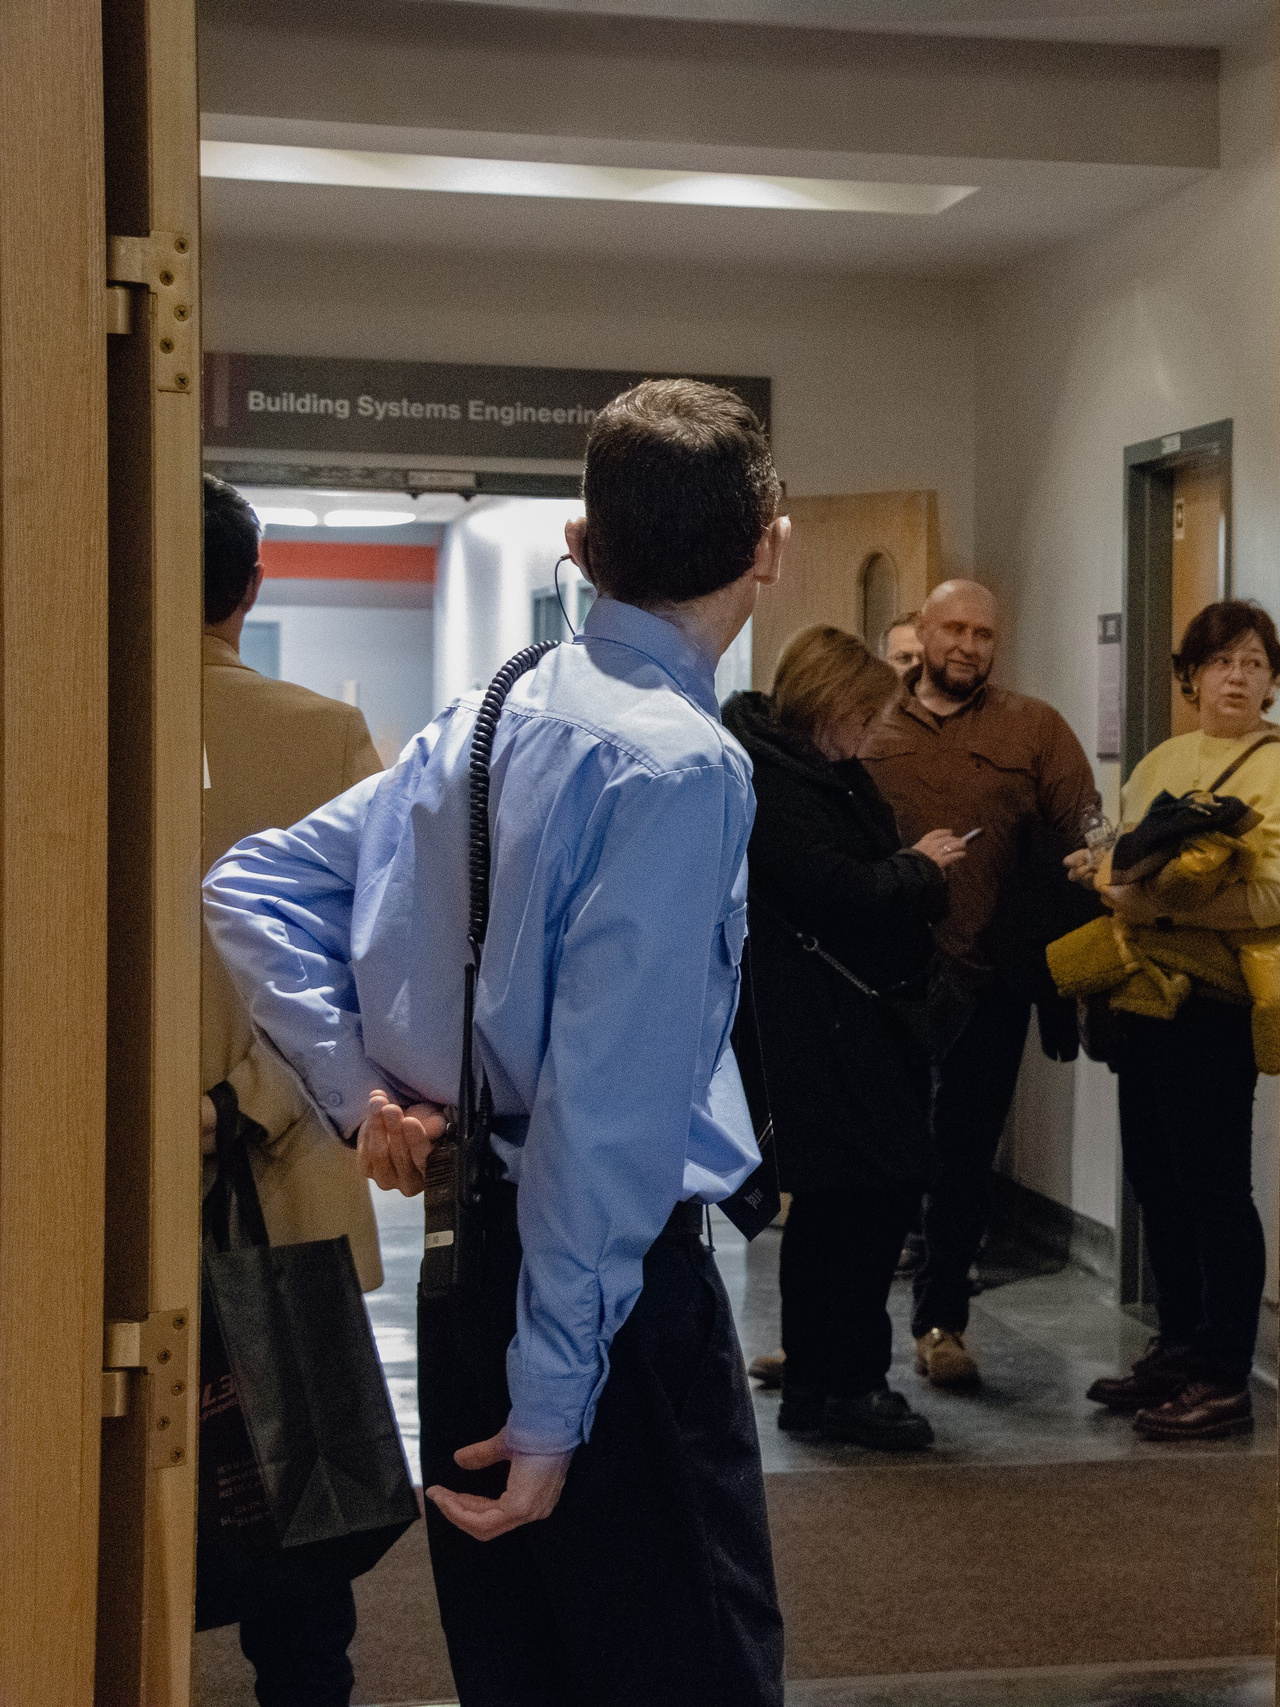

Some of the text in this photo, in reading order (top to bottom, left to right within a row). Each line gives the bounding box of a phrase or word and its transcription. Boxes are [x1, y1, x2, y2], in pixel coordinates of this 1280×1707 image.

[248, 391, 598, 426] Building Systems Engineerin
